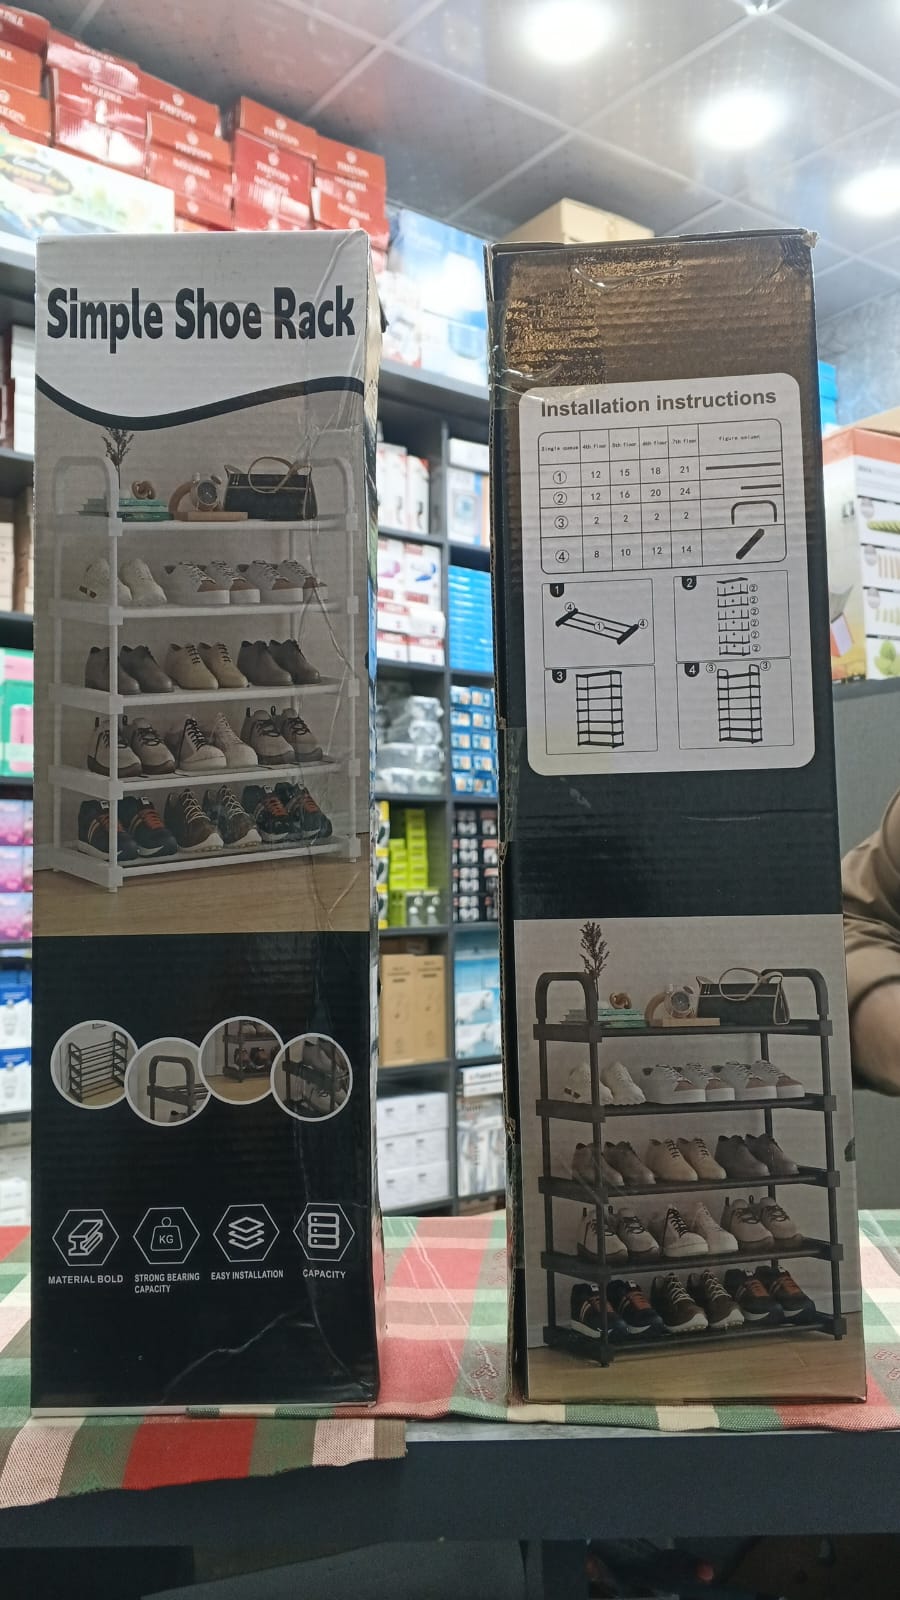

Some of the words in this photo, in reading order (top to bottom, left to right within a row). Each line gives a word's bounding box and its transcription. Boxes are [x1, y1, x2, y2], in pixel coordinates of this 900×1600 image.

[47, 287, 163, 354] Simple
[175, 287, 261, 340] Shoe
[274, 285, 355, 340] Rack
[541, 397, 650, 416] Installation
[657, 391, 776, 411] instructions
[620, 468, 630, 477] 15
[651, 467, 661, 475] 18
[680, 465, 690, 474] 21
[591, 471, 600, 479] 12
[591, 492, 600, 500] 12
[620, 491, 630, 499] 16
[651, 488, 661, 497] 20
[594, 516, 599, 524] 2
[623, 514, 628, 522] 2
[621, 548, 631, 556] 10
[653, 547, 662, 555] 12
[686, 578, 693, 588] 2
[689, 664, 696, 674] 4
[556, 672, 563, 680] 3
[159, 1234, 174, 1244] KG
[135, 1274, 164, 1282] STRONG
[167, 1272, 200, 1281] BEARING
[211, 1271, 230, 1280] EASY
[232, 1269, 284, 1279] INSTALLATION
[303, 1269, 346, 1279] CAPACITY
[48, 1275, 94, 1284] MATERIAL
[97, 1274, 124, 1283] BOLD
[135, 1285, 170, 1294] CAPACITY
